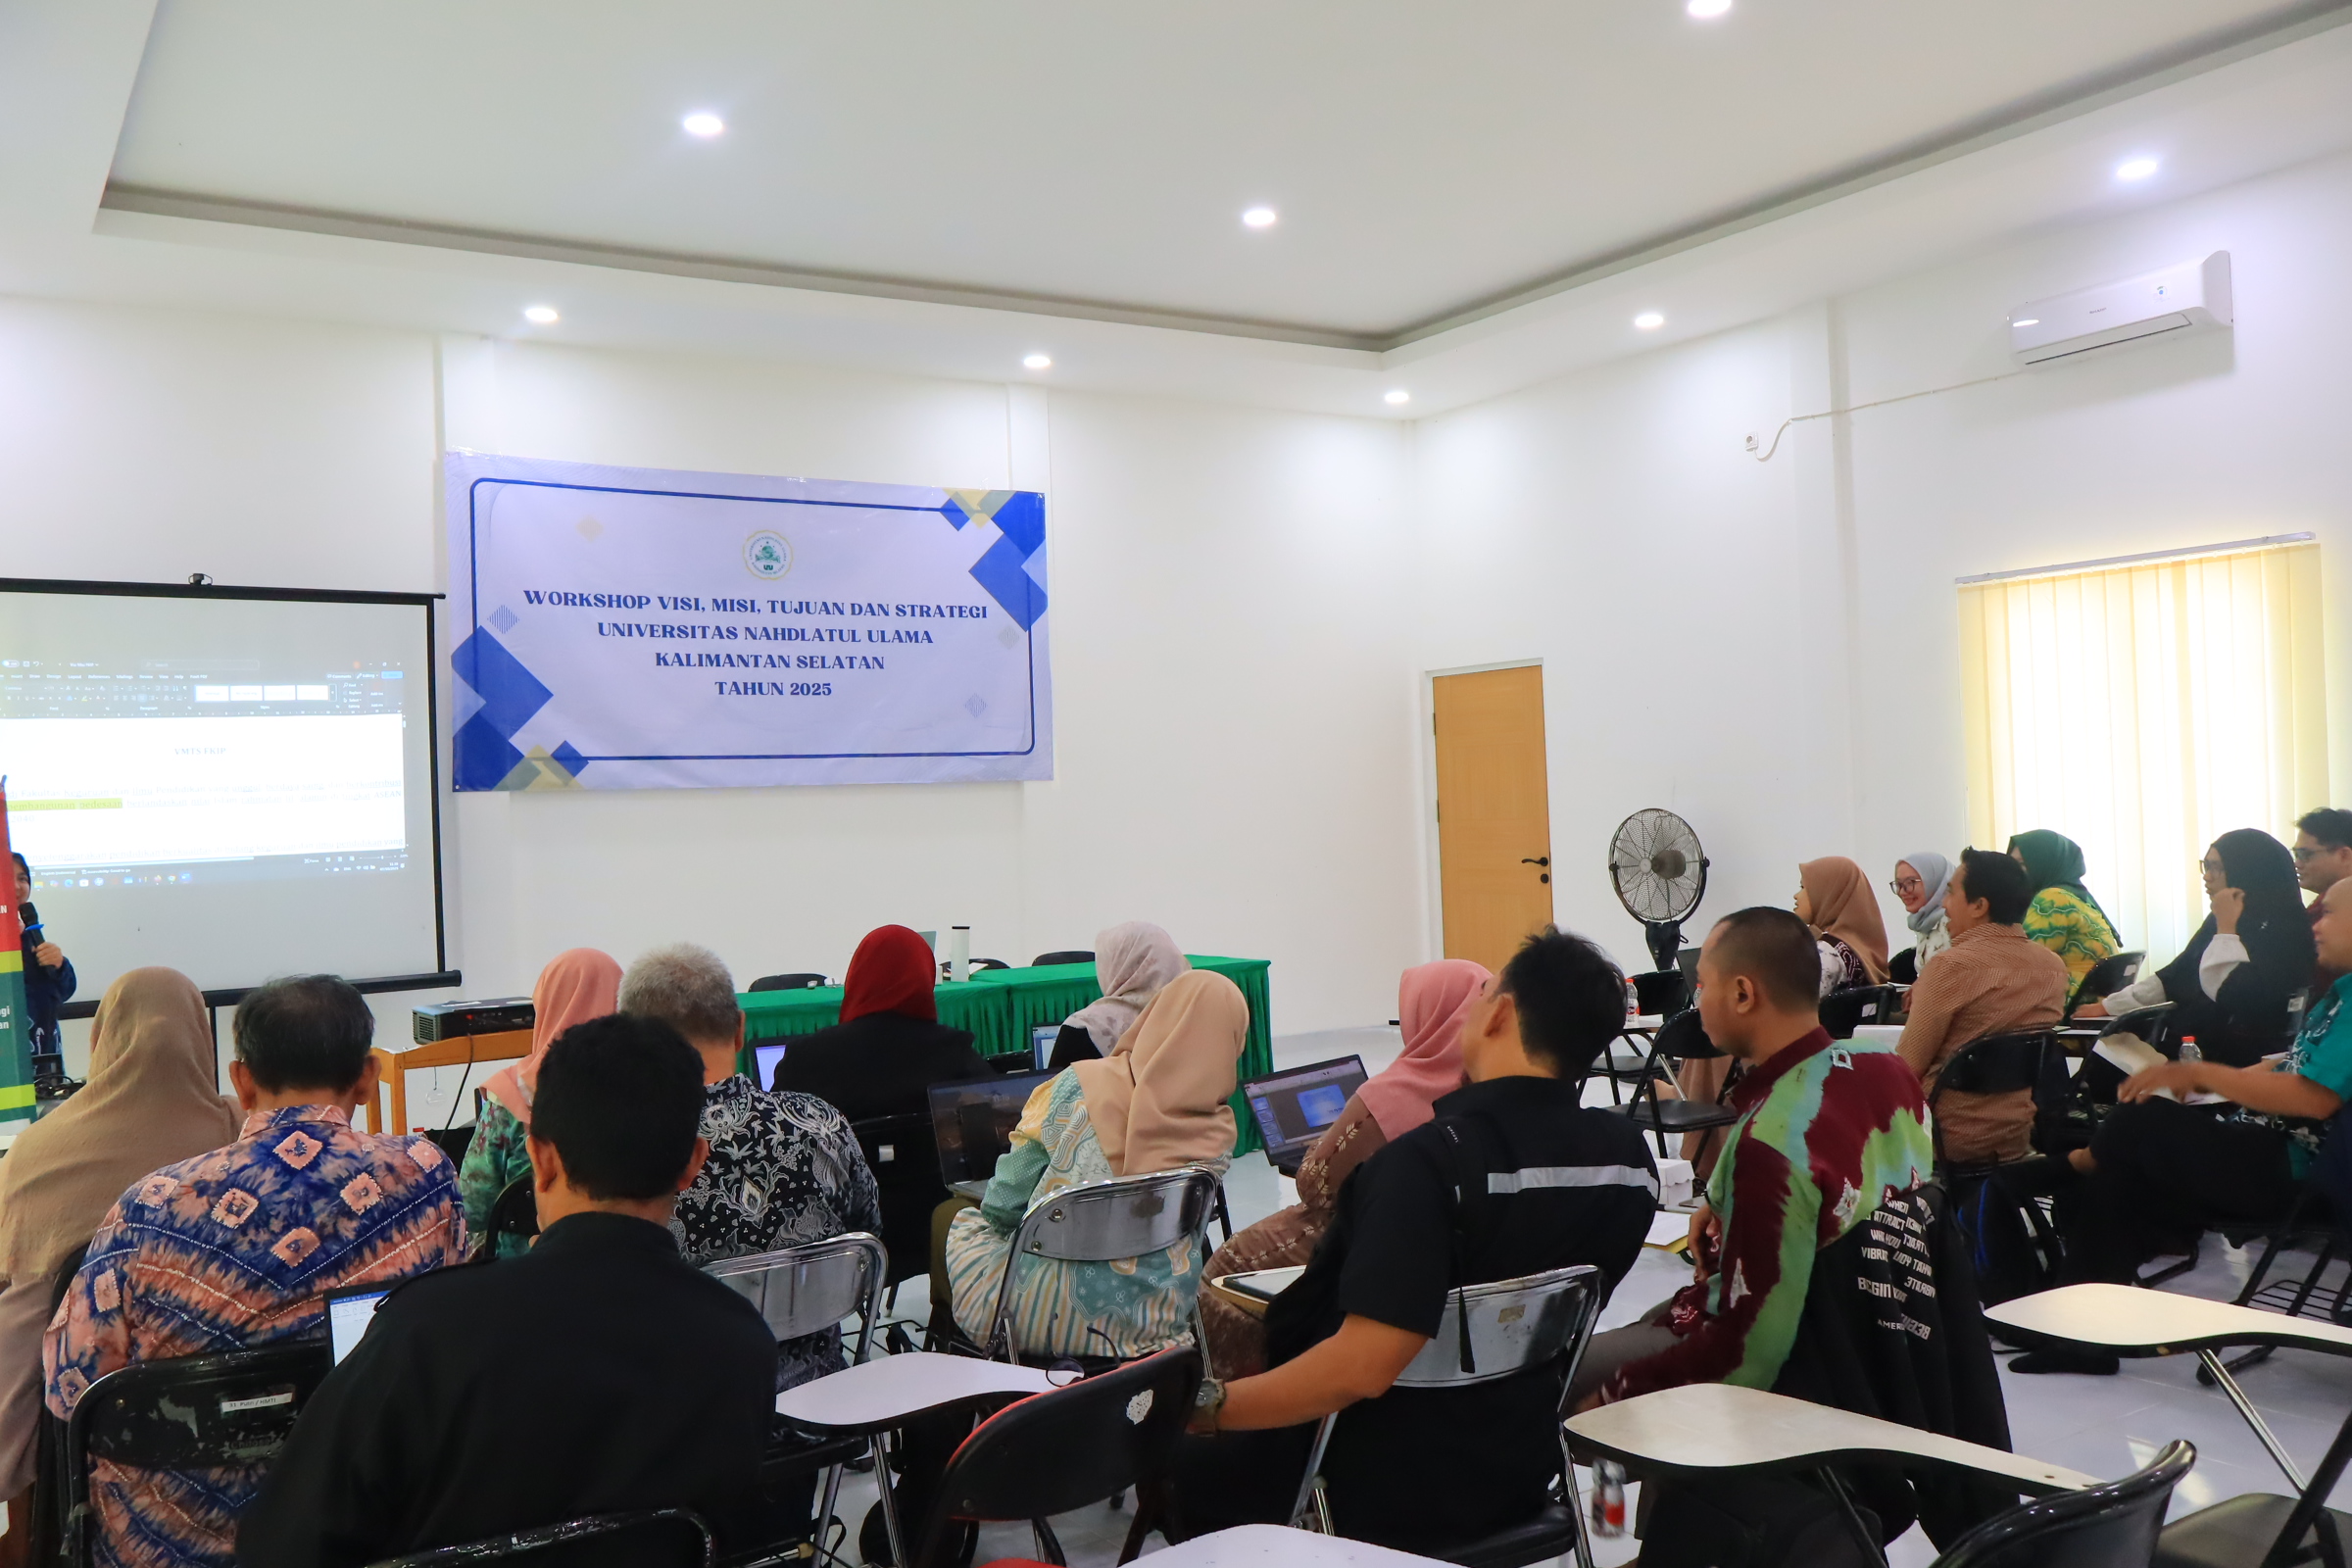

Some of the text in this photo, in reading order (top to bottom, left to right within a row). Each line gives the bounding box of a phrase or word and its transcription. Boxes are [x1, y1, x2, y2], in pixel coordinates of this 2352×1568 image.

[523, 590, 987, 618] WORKSHOP VISI, MISI, TUJUAN DAN STRATEGI
[598, 622, 933, 644] UNIVERSITAS NAHDLATUL ULAMA
[655, 652, 885, 669] KALIMANTAN SELATAN
[714, 681, 832, 696] TAHUN 2025
[78, 799, 122, 809] pedesaan
[374, 790, 402, 799] ASEAN
[1874, 1210, 1906, 1231] ATTRACT
[1858, 1277, 1891, 1298] BEGIN
